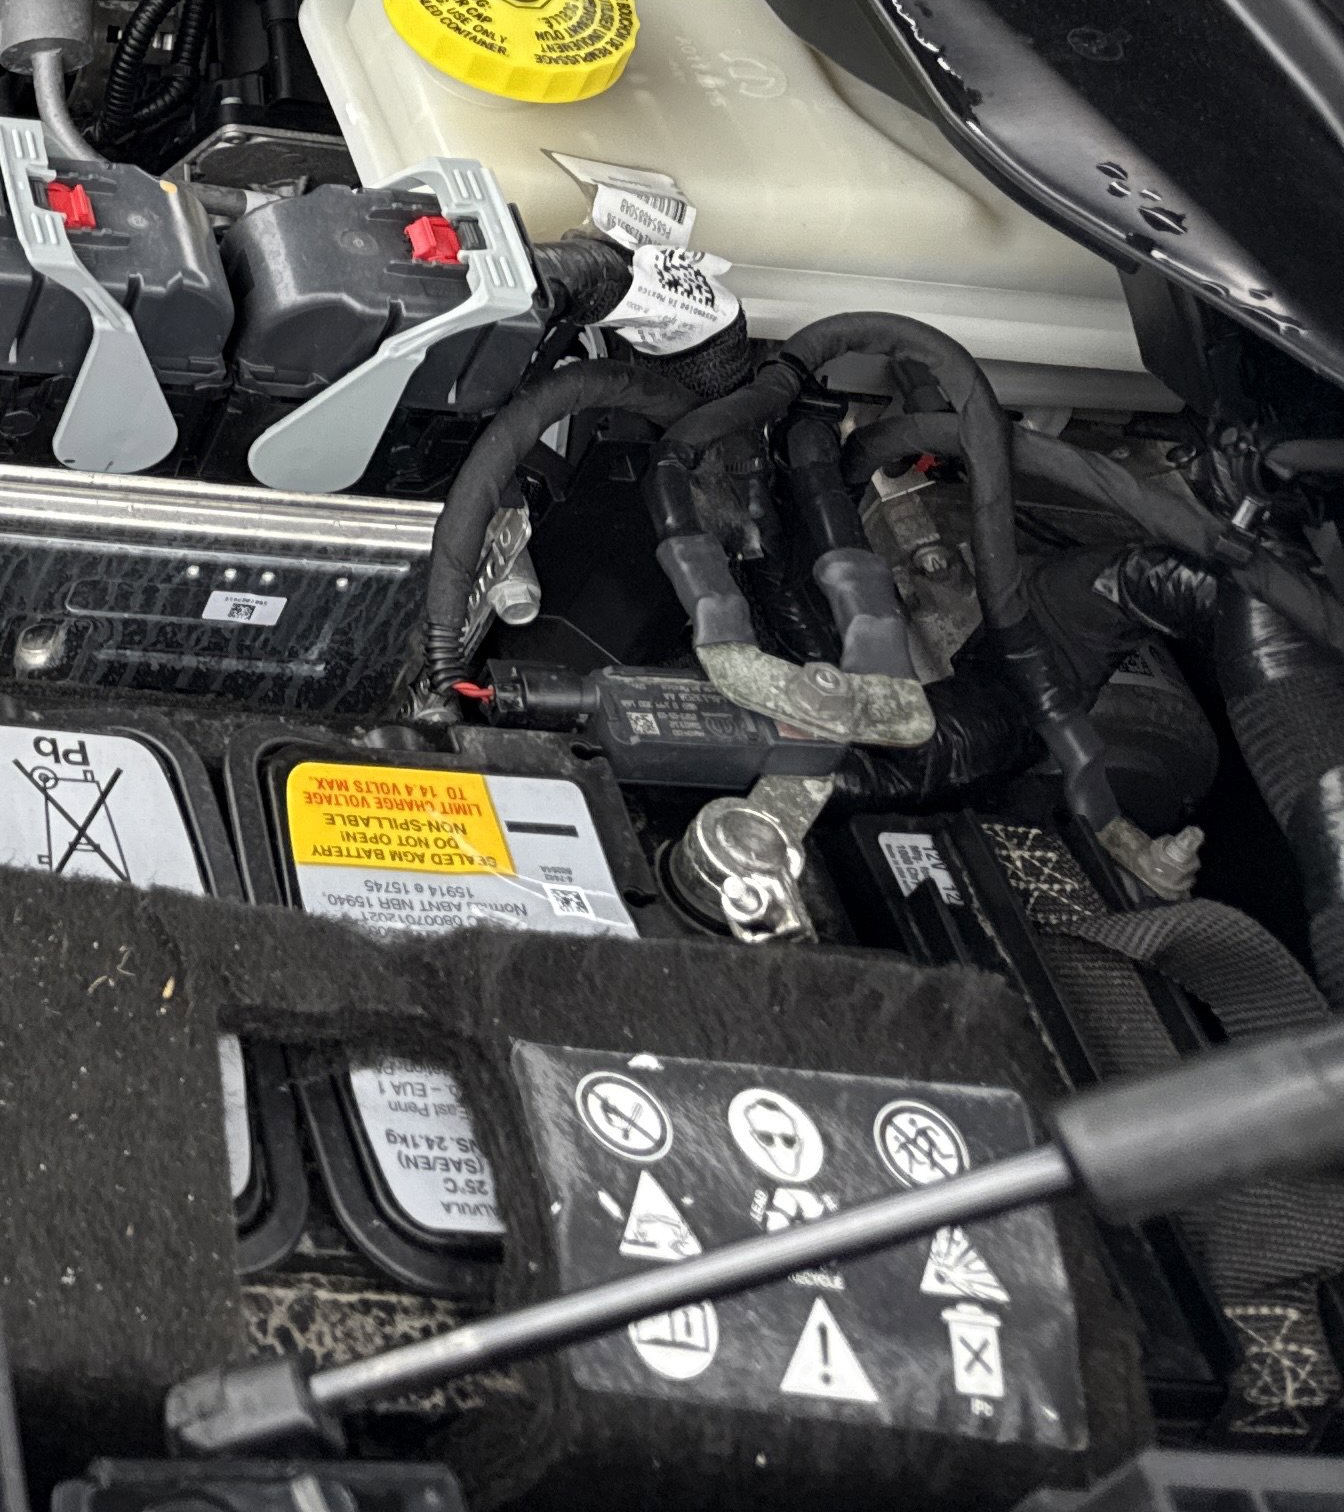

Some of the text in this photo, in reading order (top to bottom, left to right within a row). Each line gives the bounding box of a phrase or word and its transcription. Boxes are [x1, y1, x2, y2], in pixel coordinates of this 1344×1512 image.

[447, 7, 473, 26] USE
[472, 24, 507, 44] ONLY
[466, 7, 493, 23] CAP
[614, 2, 633, 41] BOUCHON
[604, 37, 624, 51] DE
[637, 285, 666, 304] Mexico
[33, 735, 90, 766] Pb
[308, 776, 464, 800] TO 14.4 VOLTS MAX.
[302, 791, 481, 816] LIMIT CHARGE VOLTAGE
[322, 812, 467, 835] NON-SPILLABLE
[340, 831, 458, 849] DO NOT OPEN!
[310, 844, 496, 868] SEALED AGM BATTERY
[922, 847, 944, 870] 12V
[363, 879, 474, 898] 15914 e 15745
[322, 892, 526, 915] Norm ABNT NBR 15940,
[390, 1081, 426, 1097] EUA
[388, 1101, 429, 1116] Penn
[384, 1129, 448, 1150] 24.1kg
[396, 1150, 484, 1173] (SAE/EN)
[443, 1178, 488, 1195] 25°C
